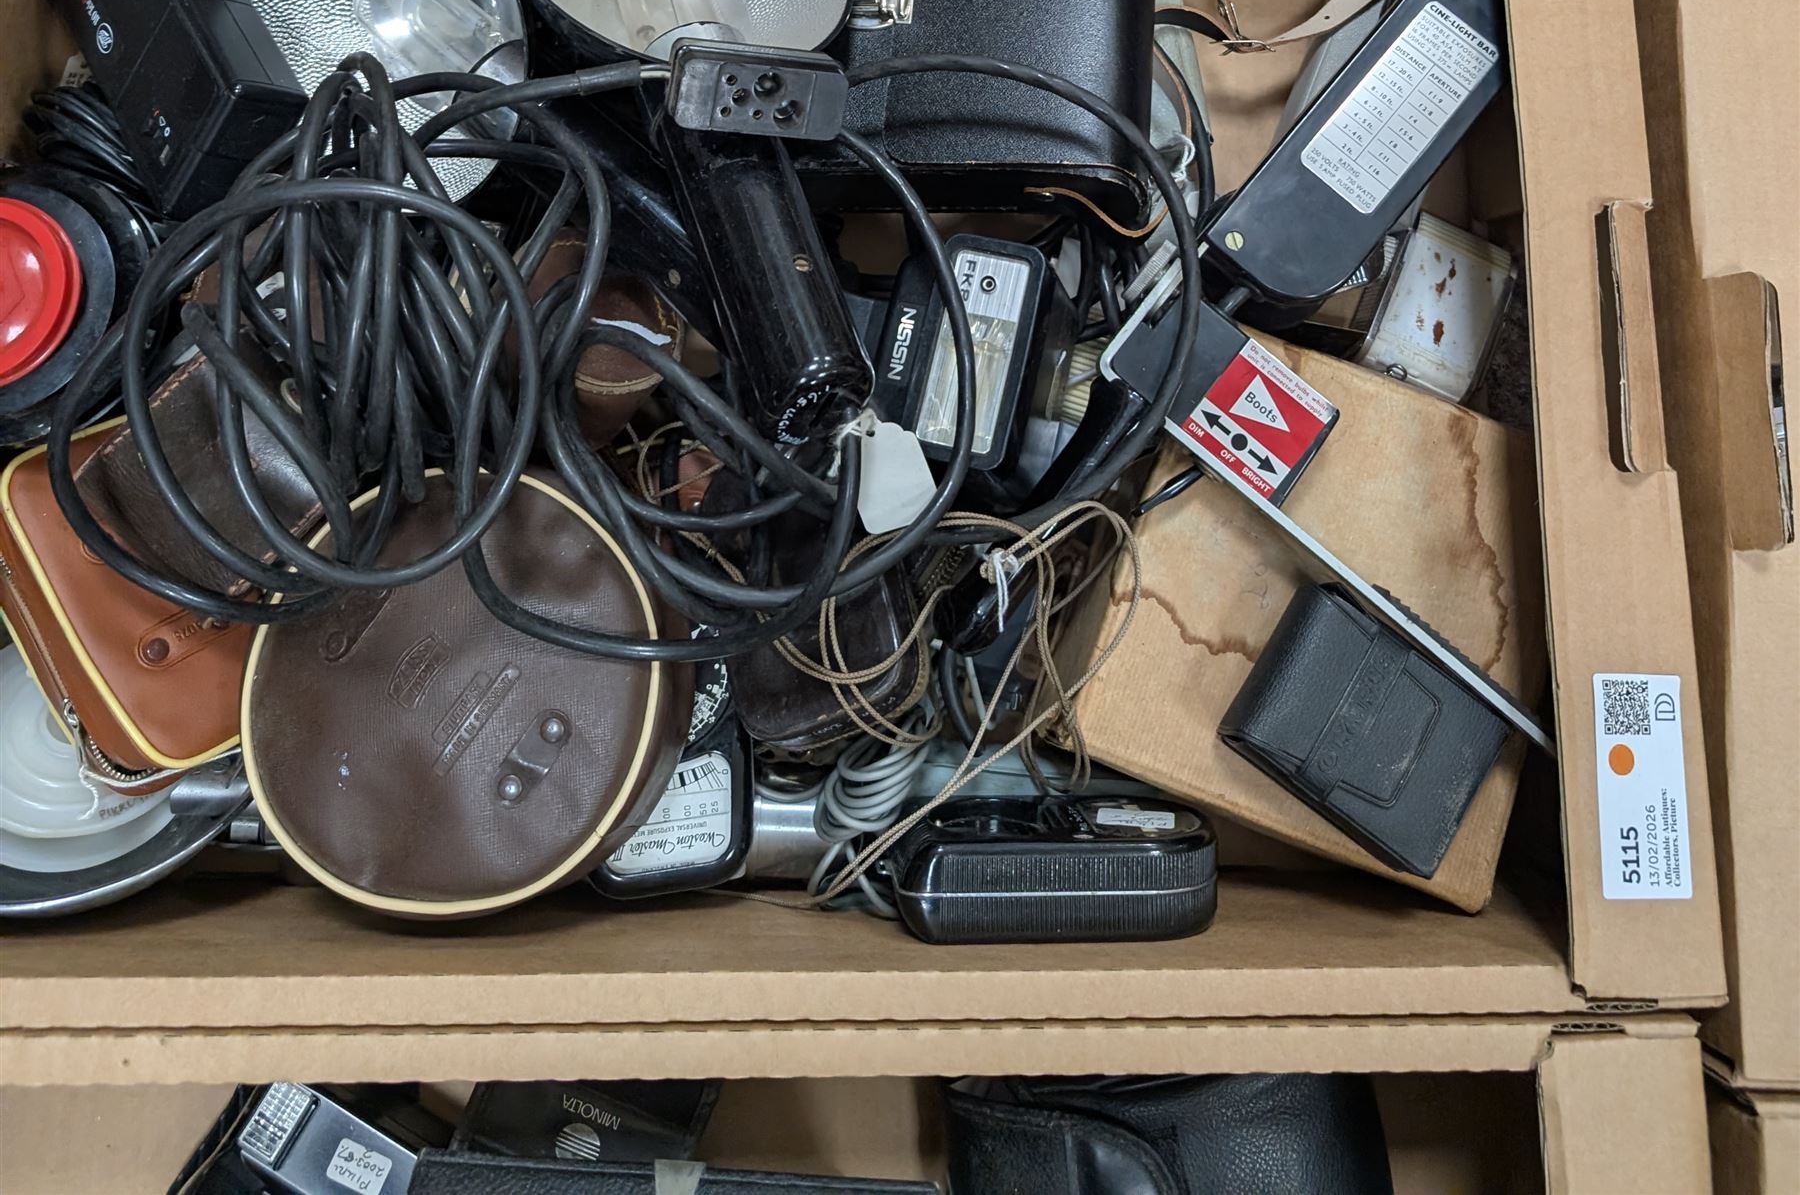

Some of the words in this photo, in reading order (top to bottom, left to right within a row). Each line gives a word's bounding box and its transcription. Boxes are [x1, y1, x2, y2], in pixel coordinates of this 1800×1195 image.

[1415, 21, 1429, 32] FOR
[1456, 52, 1471, 65] FILM
[1471, 64, 1481, 73] AT
[1417, 32, 1441, 51] FRAMES
[1440, 49, 1452, 60] PER
[1452, 59, 1478, 79] SECOND
[1420, 15, 1451, 39] SUITABLE
[1449, 38, 1488, 68] EXPOSURES
[1427, 3, 1478, 42] CINE-LIGHT
[1475, 40, 1497, 58] BAR
[1394, 45, 1427, 72] DISTANCE
[1428, 72, 1462, 99] APERTURE
[1406, 32, 1426, 49] USING
[1452, 68, 1473, 85] LAMPS
[1305, 153, 1317, 165] USE
[1322, 166, 1336, 180] AMP
[1335, 177, 1355, 195] FUSED
[1354, 193, 1372, 209] PLUG
[1310, 147, 1322, 157] 250
[1319, 154, 1340, 173] VOLTS
[1355, 183, 1377, 203] WATTS
[1337, 157, 1360, 178] RATING
[887, 306, 917, 381] NISSIN
[1247, 354, 1259, 365] unit
[1266, 370, 1295, 394] connected
[1296, 393, 1303, 401] to
[1304, 399, 1323, 417] supply
[1250, 345, 1259, 355] Do
[1260, 354, 1271, 365] not
[1272, 364, 1293, 383] remove
[1294, 382, 1310, 397] bulbs
[1244, 391, 1278, 423] Boots
[1188, 422, 1205, 438] DIM
[1220, 449, 1237, 464] OFF
[1241, 467, 1272, 493] BRIGHT
[646, 825, 675, 836] EXPOSURE
[676, 820, 708, 832] UNIVERSAL
[1660, 787, 1669, 835] Antiques:
[1669, 797, 1679, 833] Picture
[629, 837, 676, 857] Master
[676, 831, 726, 850] Weston
[1620, 826, 1641, 884] 5115
[1645, 804, 1661, 888] 13/02/2026
[1663, 835, 1673, 888] Affordable
[563, 1093, 621, 1131] MINOLTA
